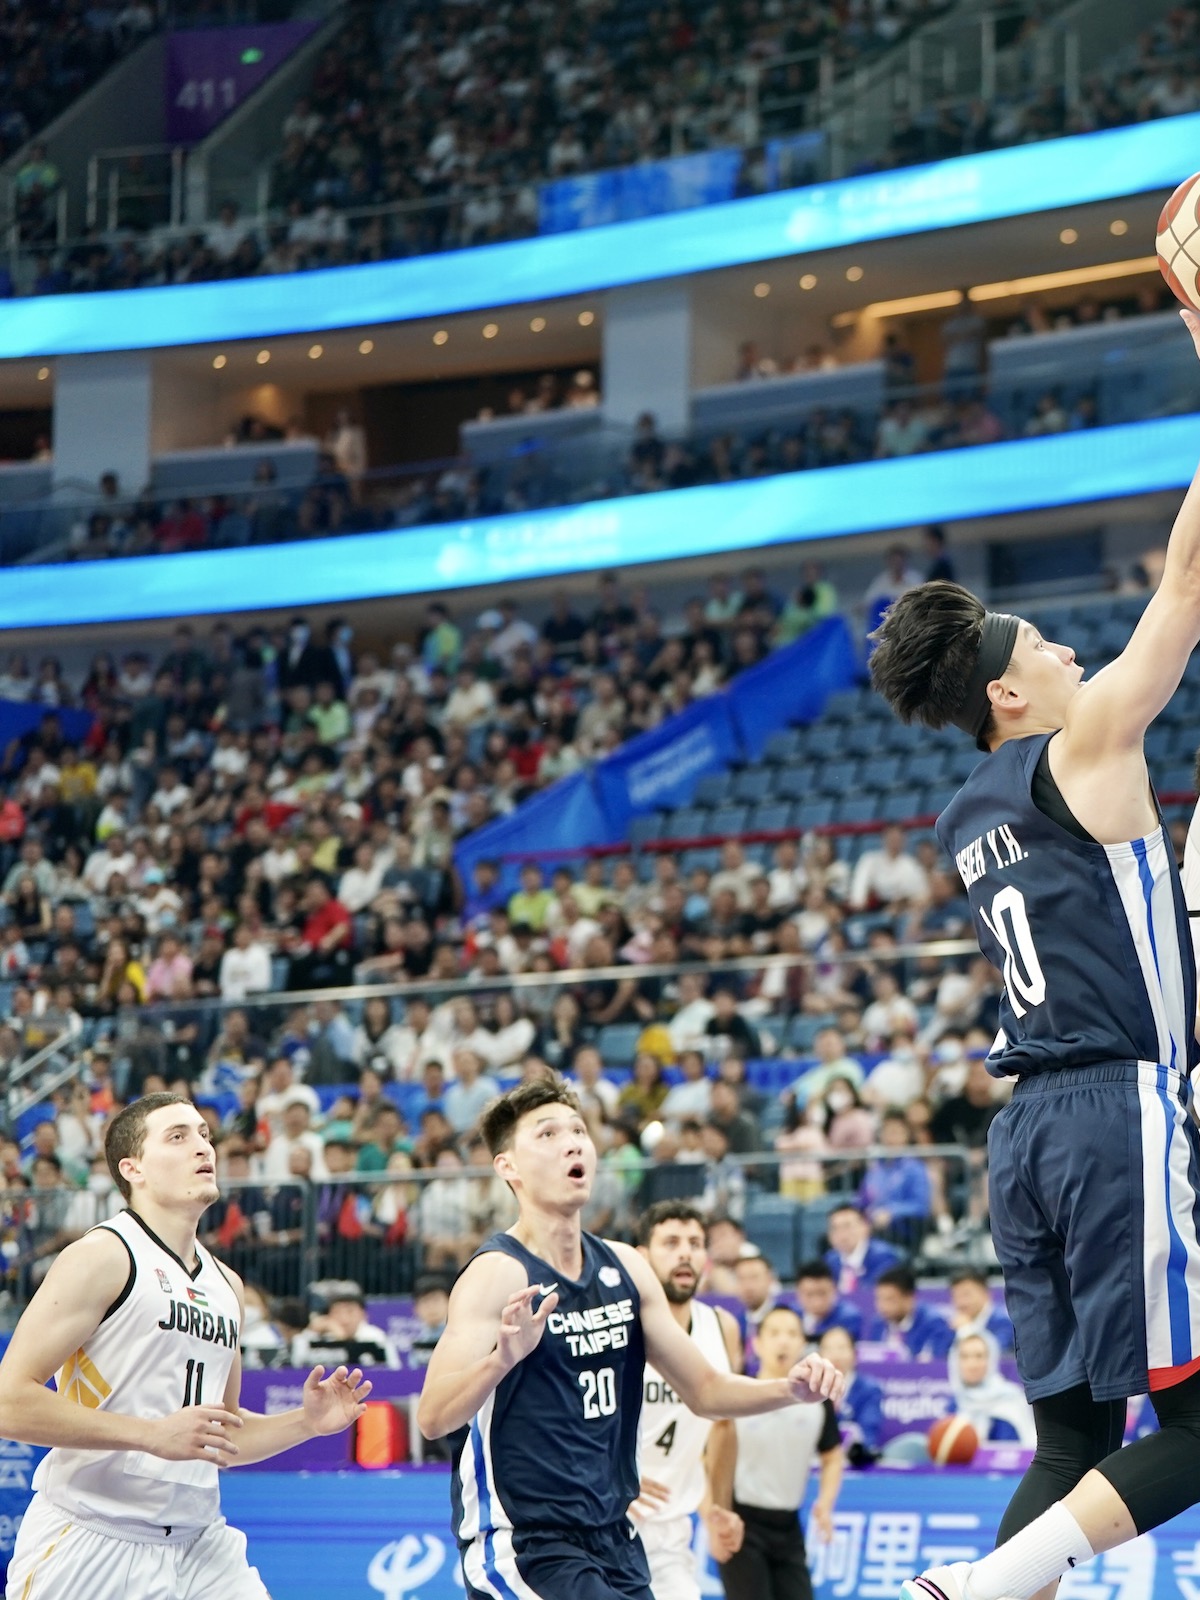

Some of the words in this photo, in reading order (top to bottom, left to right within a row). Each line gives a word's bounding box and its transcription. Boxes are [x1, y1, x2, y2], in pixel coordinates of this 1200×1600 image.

[177, 79, 236, 110] 411
[978, 885, 1047, 1019] 10
[158, 1299, 238, 1351] JORDAN
[547, 1298, 635, 1334] CHINESE
[565, 1325, 629, 1357] TAIPEI
[182, 1358, 205, 1408] 11
[578, 1366, 617, 1419] 20
[655, 1418, 677, 1456] 4
